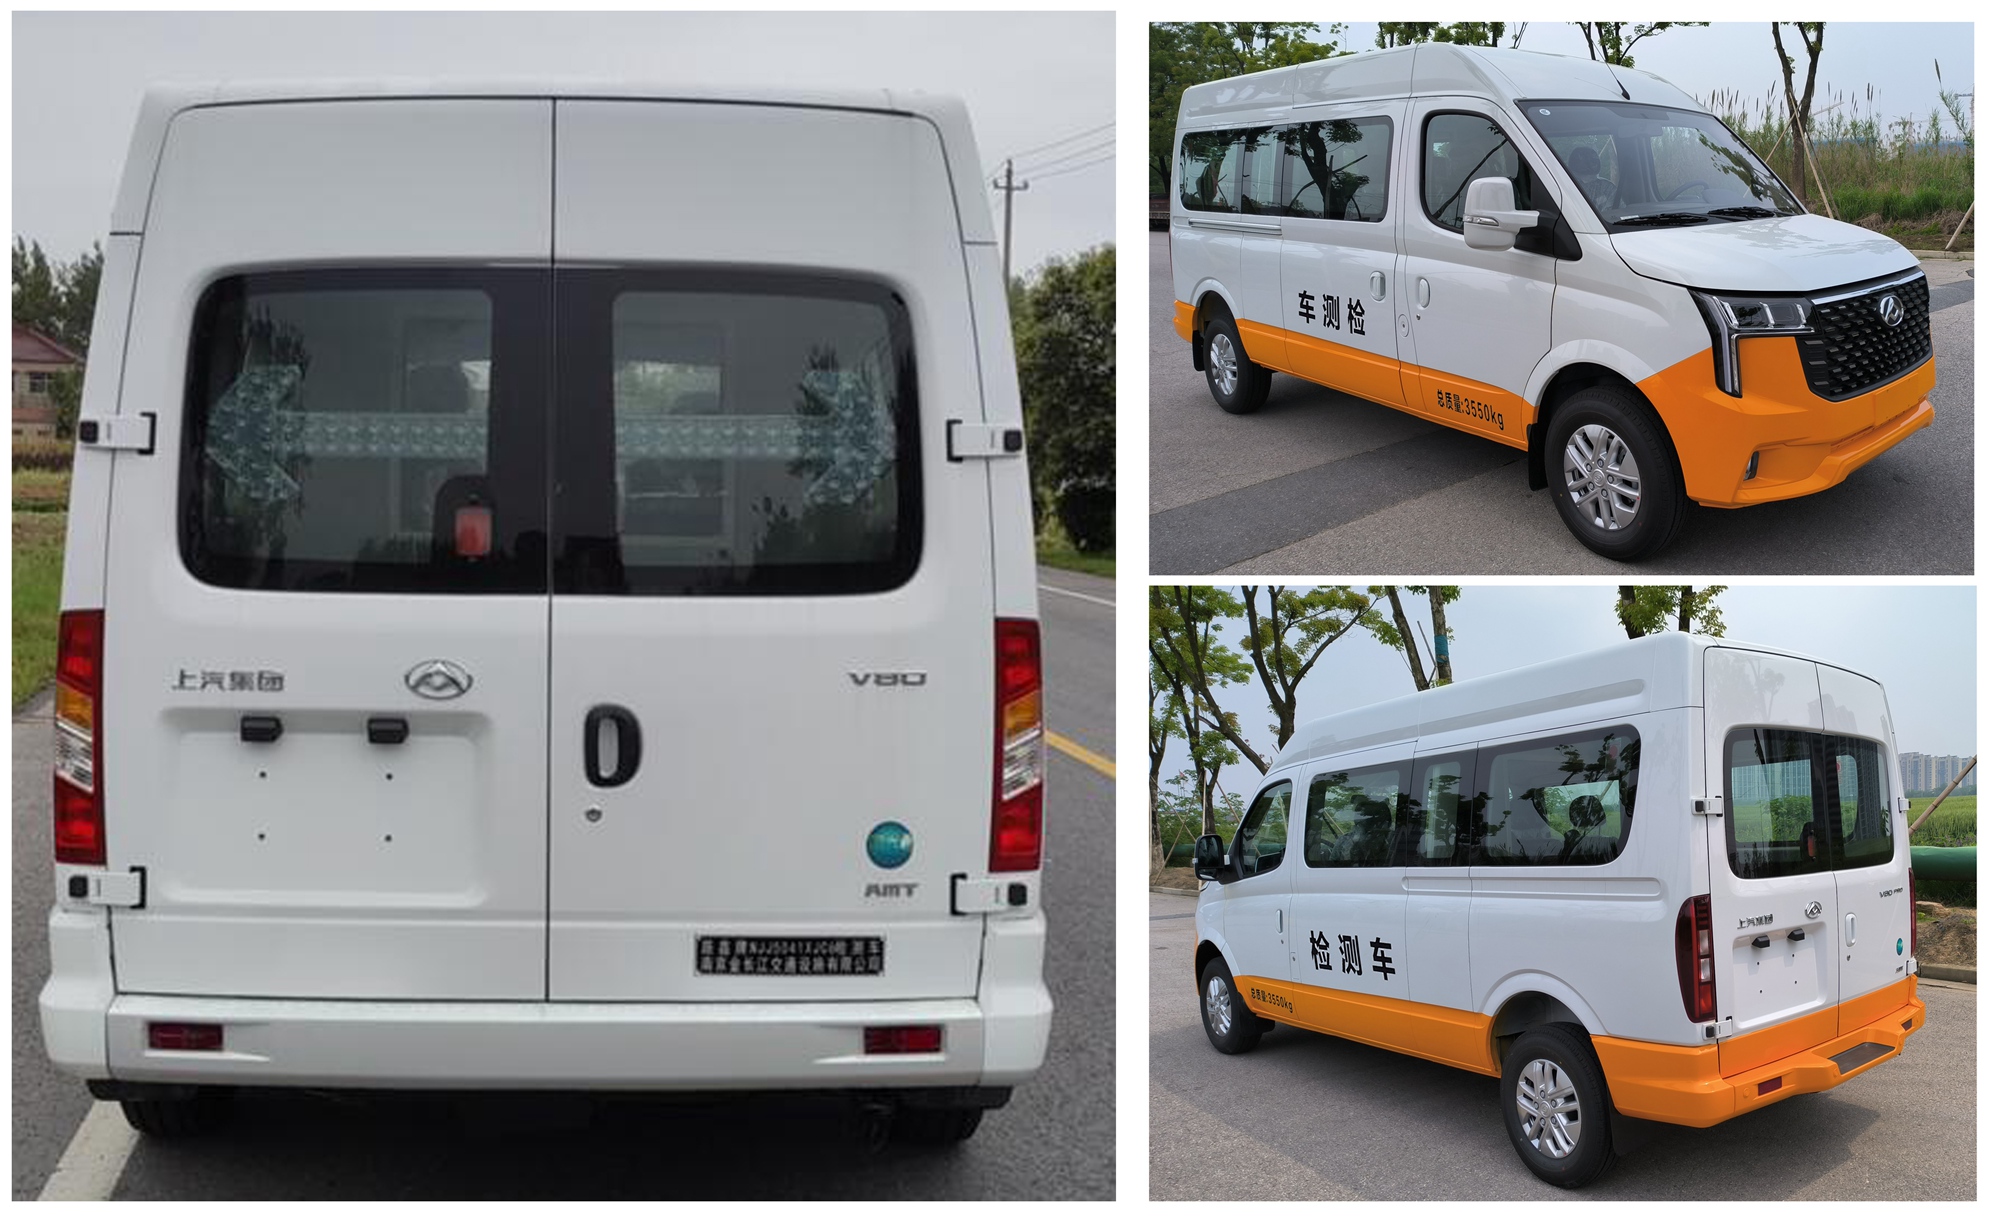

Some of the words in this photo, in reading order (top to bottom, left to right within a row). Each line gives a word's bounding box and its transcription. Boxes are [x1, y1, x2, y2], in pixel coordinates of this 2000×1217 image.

[171, 669, 285, 692] 上汽集团
[848, 672, 928, 686] V80
[864, 883, 920, 898] AMT
[1309, 930, 1396, 981] 检测车
